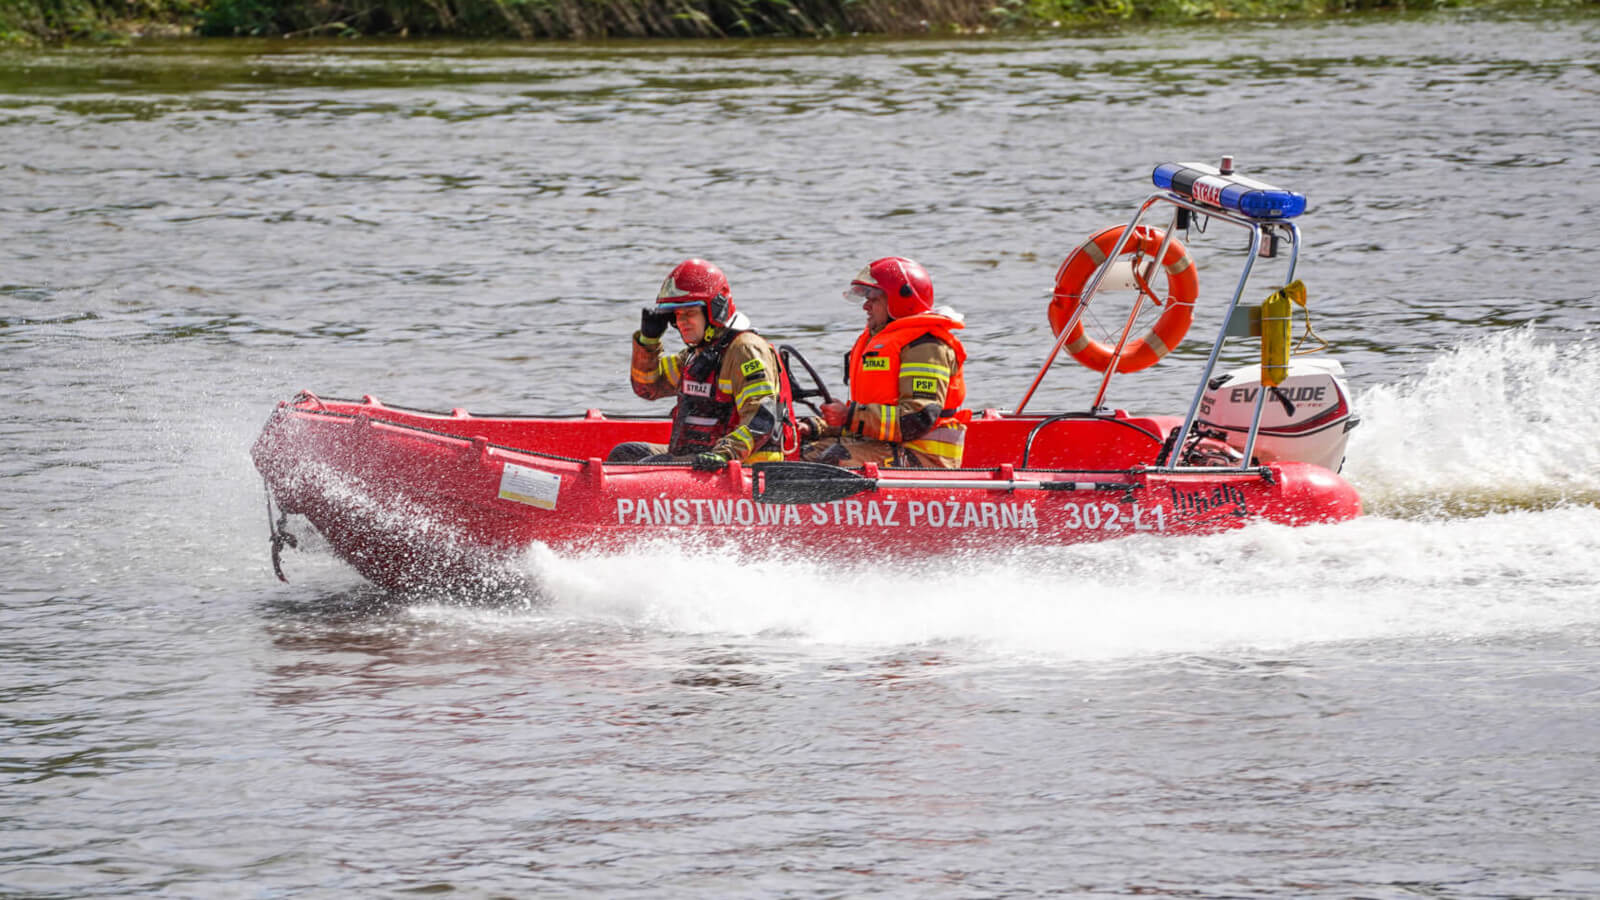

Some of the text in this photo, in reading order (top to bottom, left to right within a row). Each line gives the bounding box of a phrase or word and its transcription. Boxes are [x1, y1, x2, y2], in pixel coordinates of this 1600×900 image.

[744, 359, 761, 373] PSP
[916, 381, 933, 390] PSP
[1230, 386, 1326, 403] EVRUDE
[617, 492, 1165, 531] PAŃSTWOWA STRAŻ POŻARNA 302-Ł1
